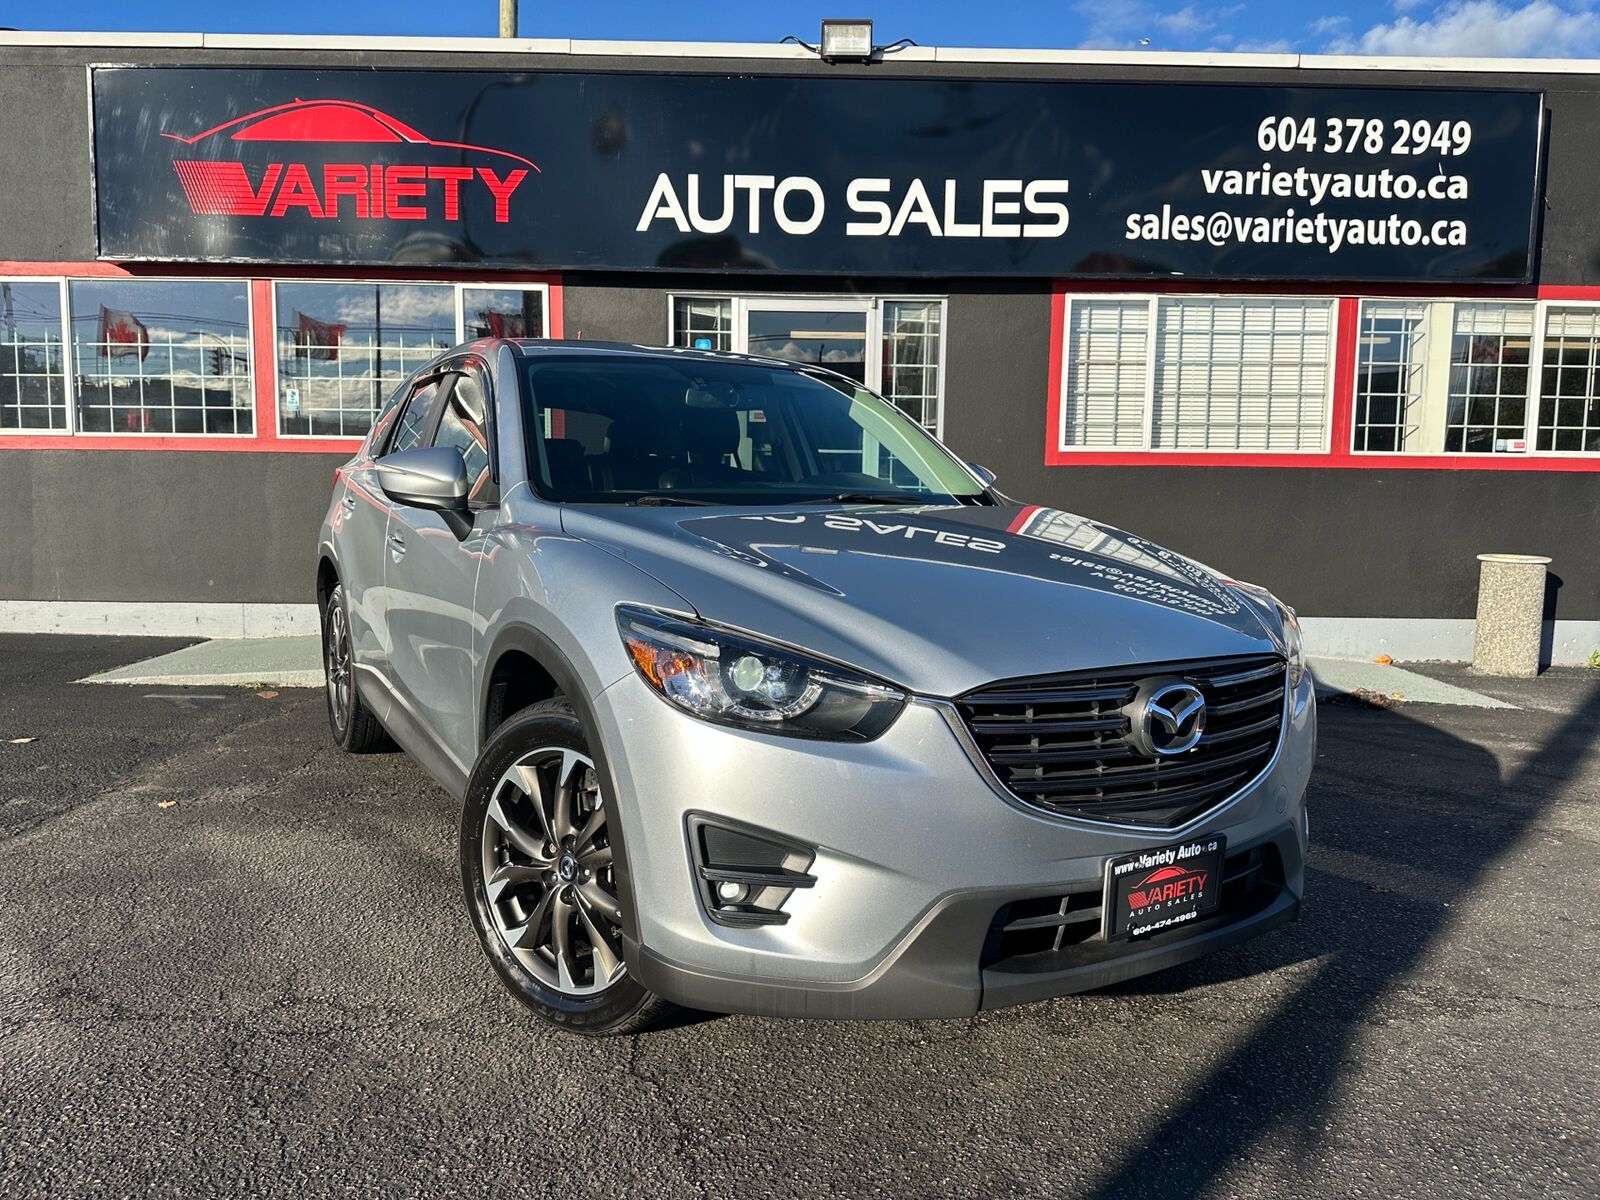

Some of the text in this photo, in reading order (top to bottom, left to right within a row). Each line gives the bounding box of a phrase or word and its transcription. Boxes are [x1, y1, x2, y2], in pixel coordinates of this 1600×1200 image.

[1256, 116, 1472, 157] 604 378 2949
[172, 159, 529, 223] VARIETY
[635, 172, 1070, 238] AUTO SALES
[1201, 163, 1468, 206] varietyauto.ca
[1125, 204, 1467, 253] sales@varietyauto.ca
[1128, 874, 1207, 910] VARIETY
[1129, 891, 1203, 918] AUTO SALES
[1133, 911, 1197, 936] 604-474-4969
